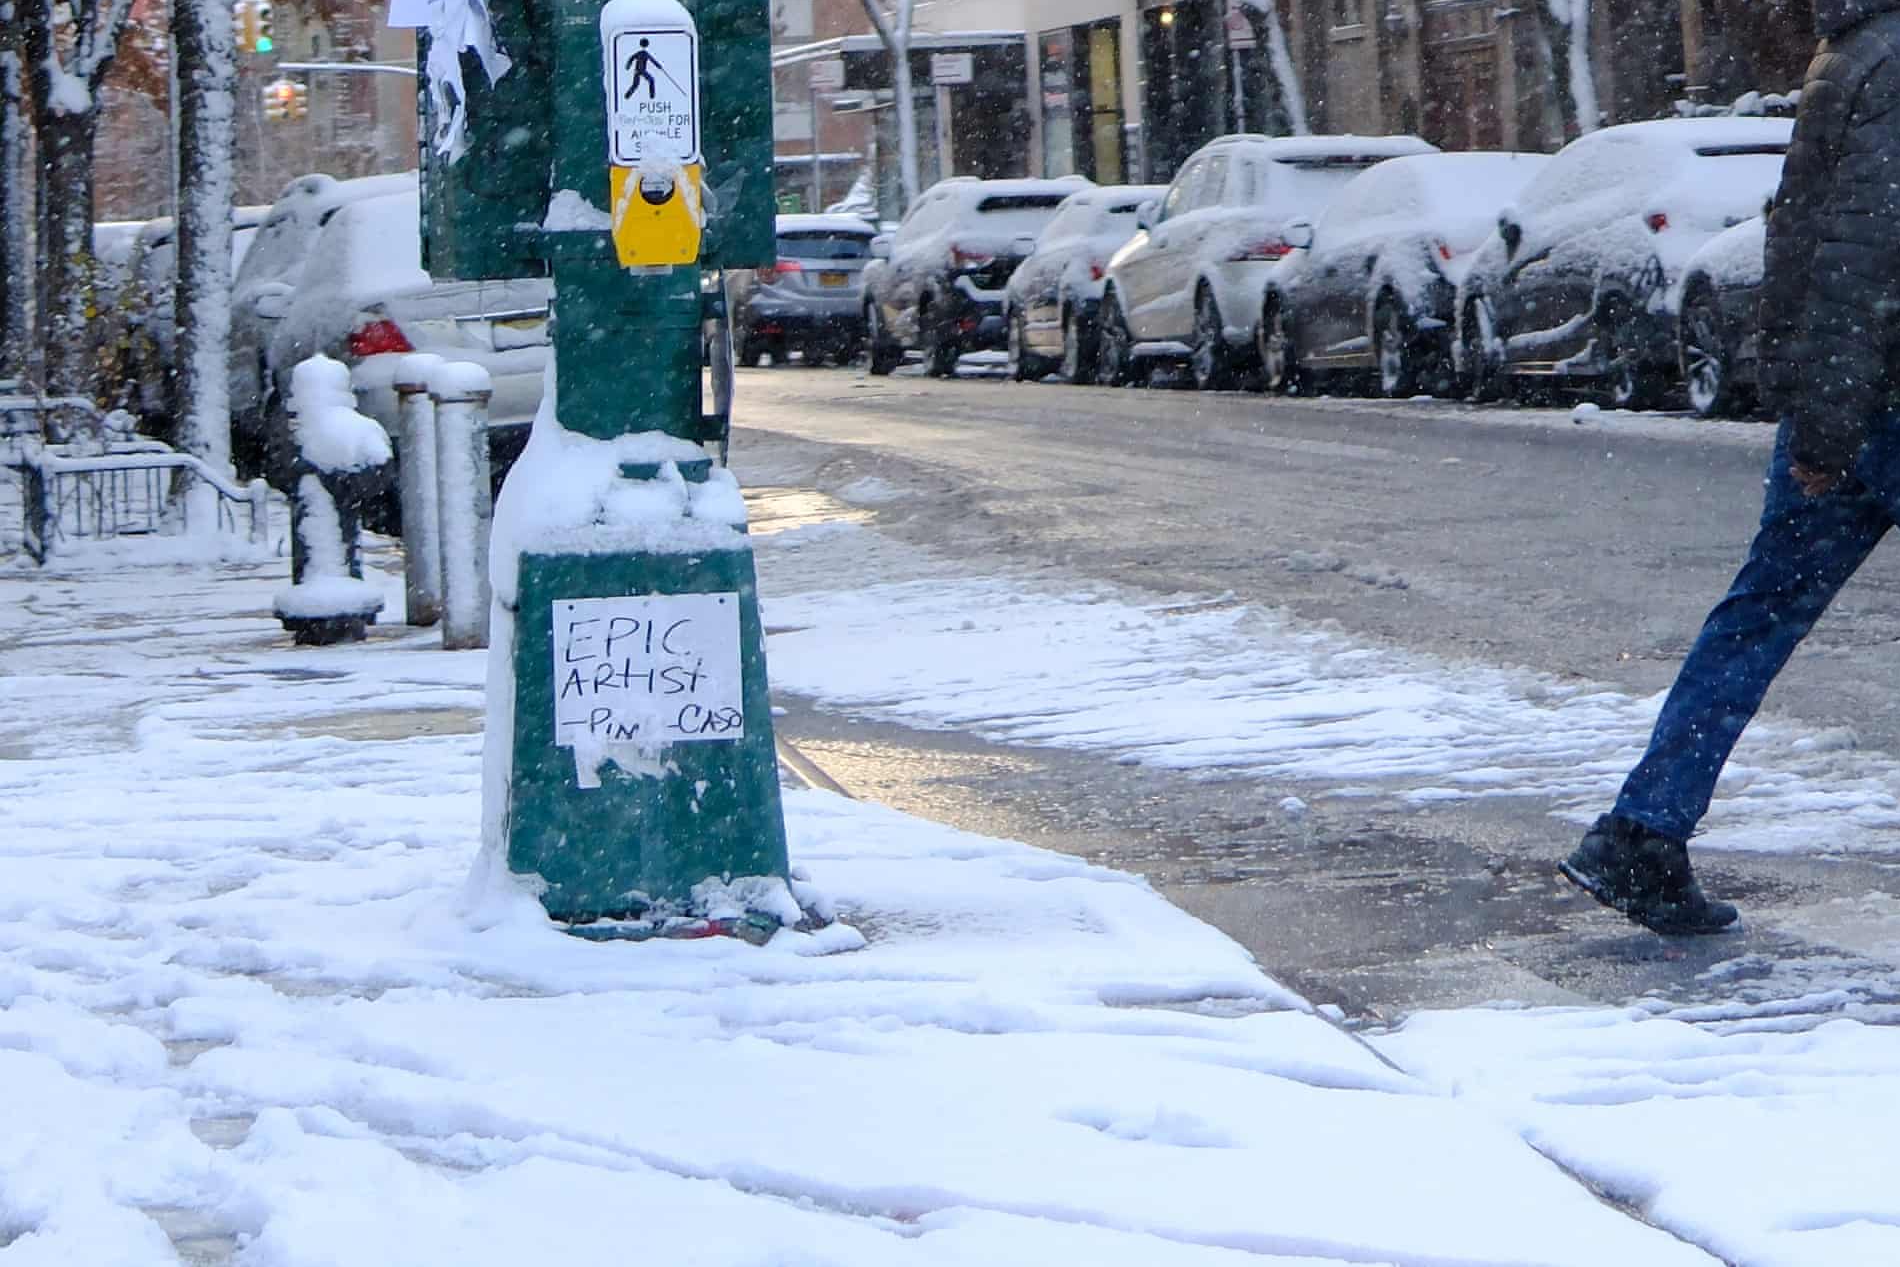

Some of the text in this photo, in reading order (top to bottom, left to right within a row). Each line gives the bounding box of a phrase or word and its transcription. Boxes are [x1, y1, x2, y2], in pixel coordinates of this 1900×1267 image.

[639, 101, 672, 114] PUSH
[668, 114, 690, 126] FOR
[566, 616, 692, 663] EPIC
